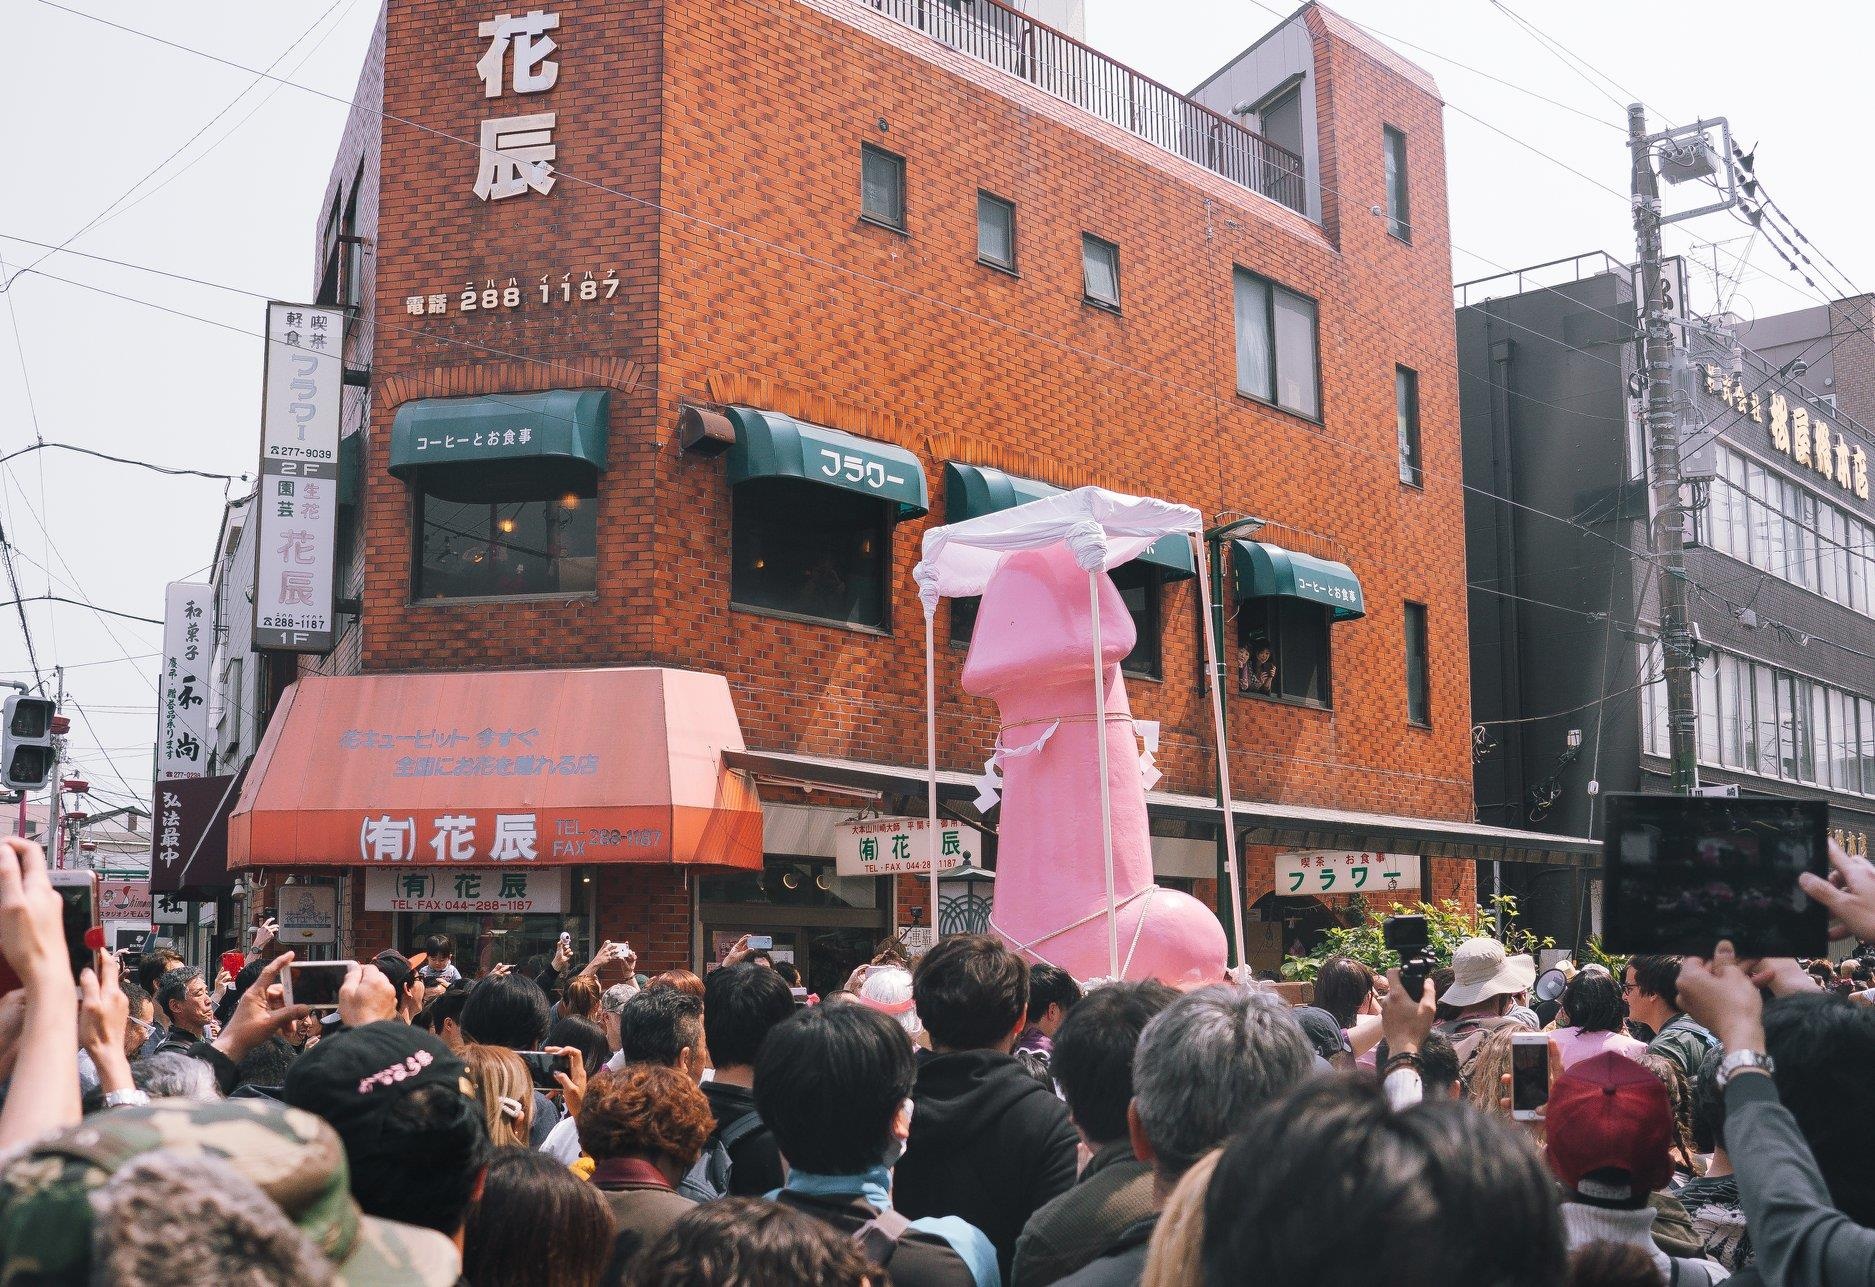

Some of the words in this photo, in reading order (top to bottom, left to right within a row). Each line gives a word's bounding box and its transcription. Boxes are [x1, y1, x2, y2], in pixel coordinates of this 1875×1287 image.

[472, 10, 560, 201] 花辰
[406, 293, 447, 315] 電話
[460, 287, 520, 311] 288
[539, 278, 619, 303] 1187
[284, 312, 303, 346] 軽食
[310, 315, 328, 349] 喫茶
[289, 353, 319, 441] フラワー
[281, 447, 332, 459] 277-9039
[416, 428, 533, 451] コーヒーとお食事
[820, 448, 906, 489] フラワー
[277, 481, 294, 518] 園芸
[301, 483, 320, 519] 生花
[277, 529, 315, 606] 花辰
[1298, 578, 1357, 603] コーヒーとお食事
[184, 599, 203, 661] 和菓子
[274, 617, 325, 630] 288-1187
[476, 727, 541, 749] 今すぐ
[159, 791, 182, 868] 弘法最中
[553, 840, 586, 857] FAX
[589, 828, 663, 848] 288-1187
[852, 822, 901, 835] 大本山川崎大師
[1301, 852, 1386, 868] 喫茶・お食事
[1288, 867, 1401, 893] フラワー
